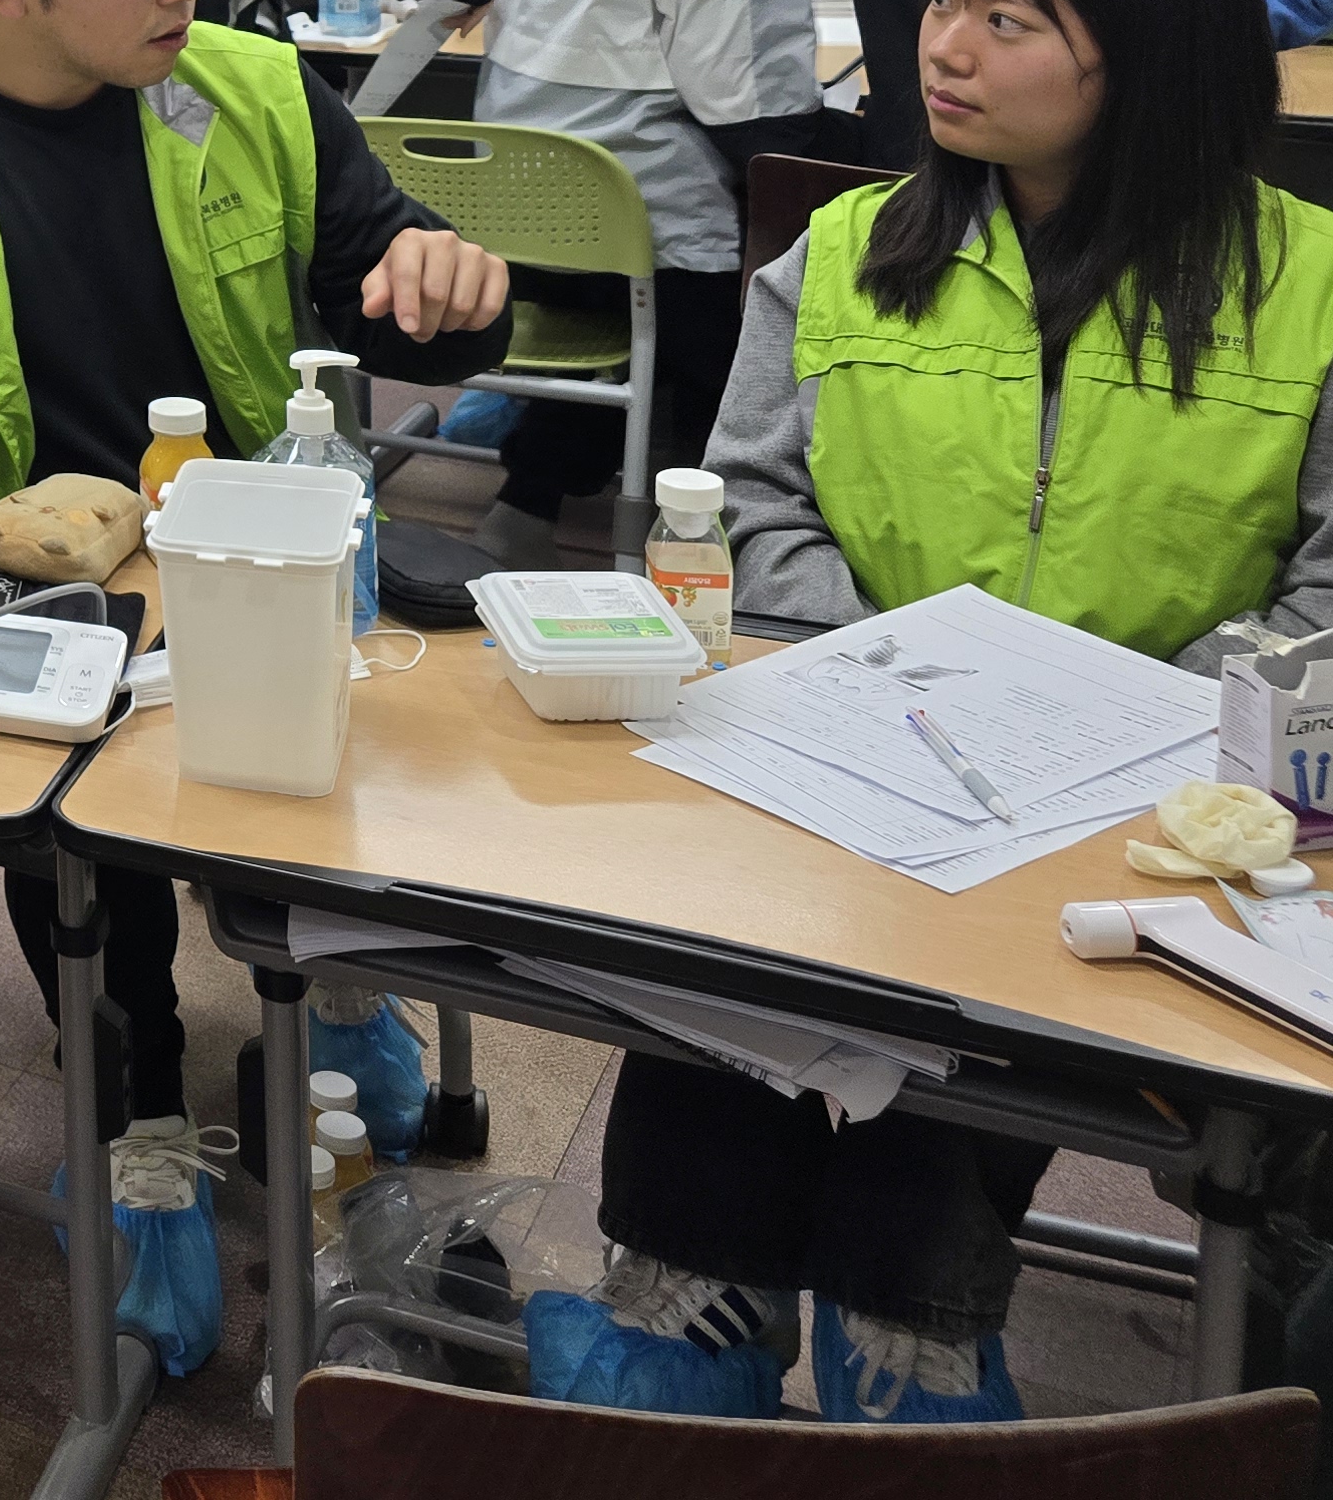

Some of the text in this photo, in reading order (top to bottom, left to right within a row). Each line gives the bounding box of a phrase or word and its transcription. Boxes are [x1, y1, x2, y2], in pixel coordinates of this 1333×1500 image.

[79, 632, 115, 642] CITIZEN
[79, 669, 93, 678] M
[69, 685, 93, 693] START
